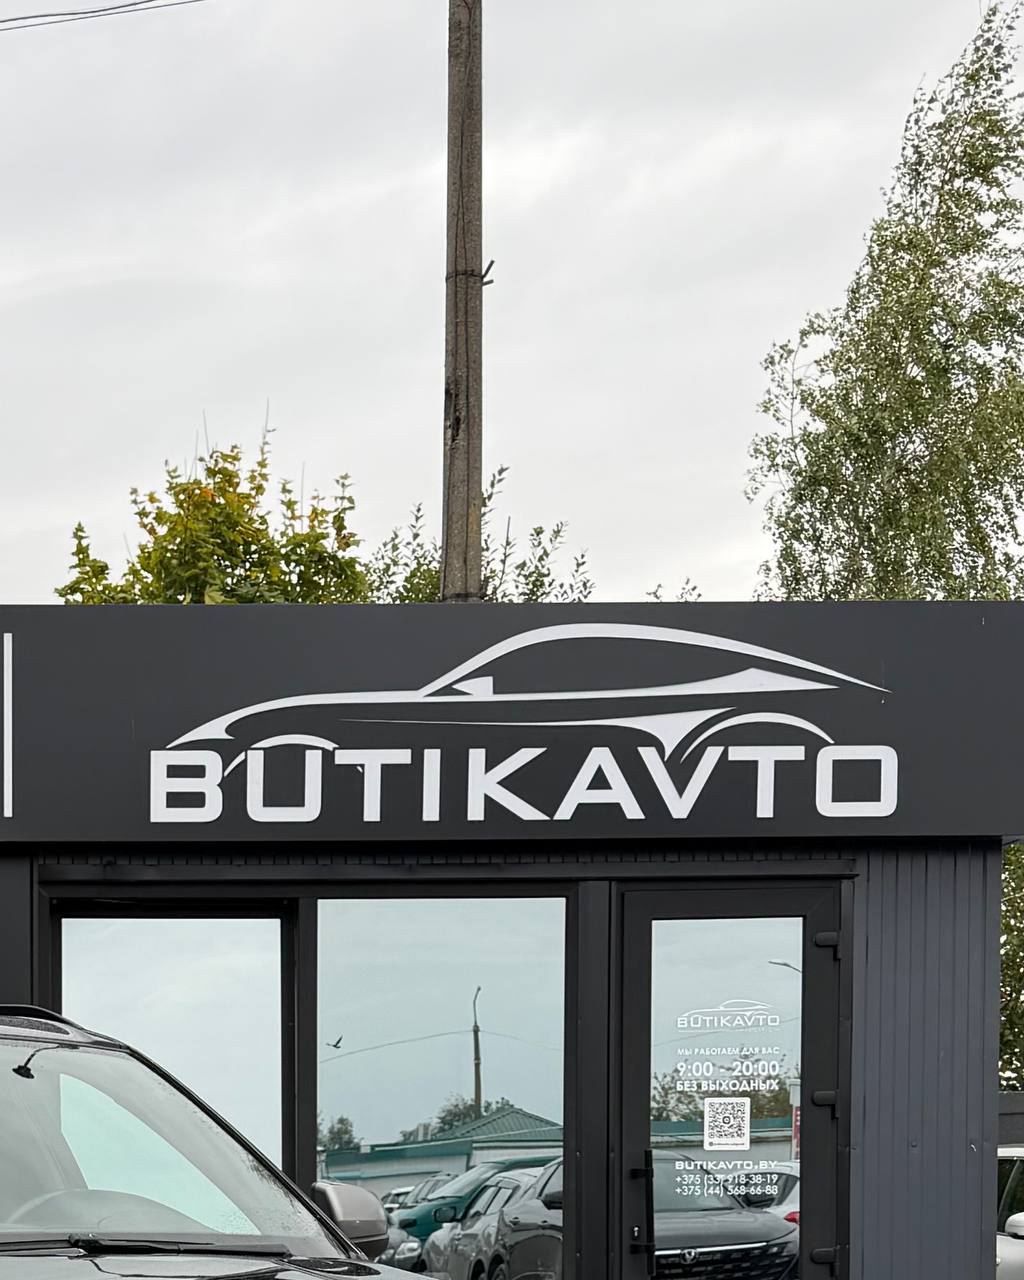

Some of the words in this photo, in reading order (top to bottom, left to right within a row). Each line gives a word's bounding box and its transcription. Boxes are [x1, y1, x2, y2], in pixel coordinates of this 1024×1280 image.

[149, 743, 899, 823] BUTIKAVTO
[677, 1015, 780, 1027] BUTIKAVTO
[677, 1062, 714, 1077] 9:00
[732, 1061, 780, 1076] 20:00
[676, 1081, 697, 1091] БЕЗ
[701, 1080, 779, 1092] ВЫХОДНЫХ
[676, 1161, 777, 1170] BUTIKAVTO.BY
[676, 1175, 701, 1184] +375
[726, 1174, 779, 1184] 918-38-19
[676, 1186, 701, 1195] +375
[704, 1185, 724, 1197] (44)
[727, 1185, 779, 1195] 568-66-88
